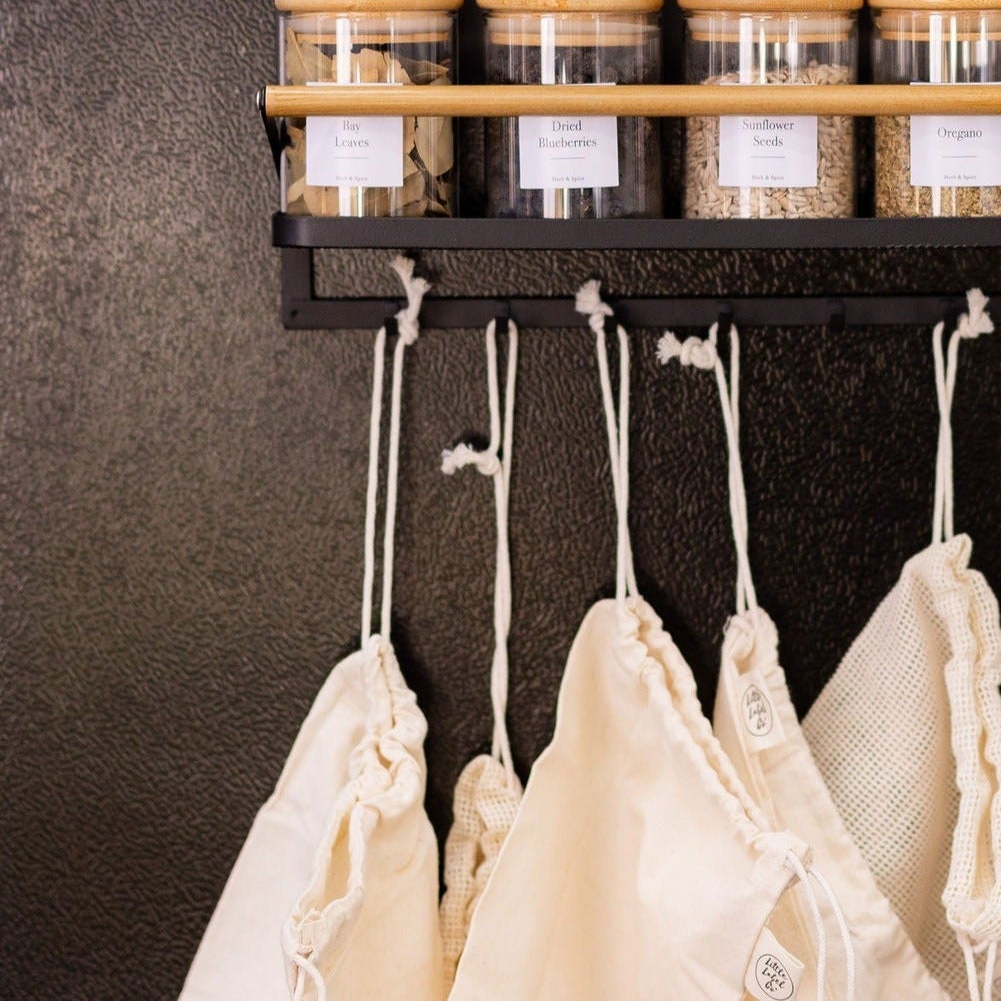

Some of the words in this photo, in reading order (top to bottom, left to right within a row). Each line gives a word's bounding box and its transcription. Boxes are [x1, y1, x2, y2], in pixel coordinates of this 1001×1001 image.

[343, 120, 361, 133] Bay
[552, 120, 582, 132] Dried
[742, 119, 795, 131] Sunflower
[937, 127, 983, 141] Oregano
[335, 136, 370, 148] Leaves
[538, 137, 597, 149] Blueberries
[753, 135, 784, 147] Seeds
